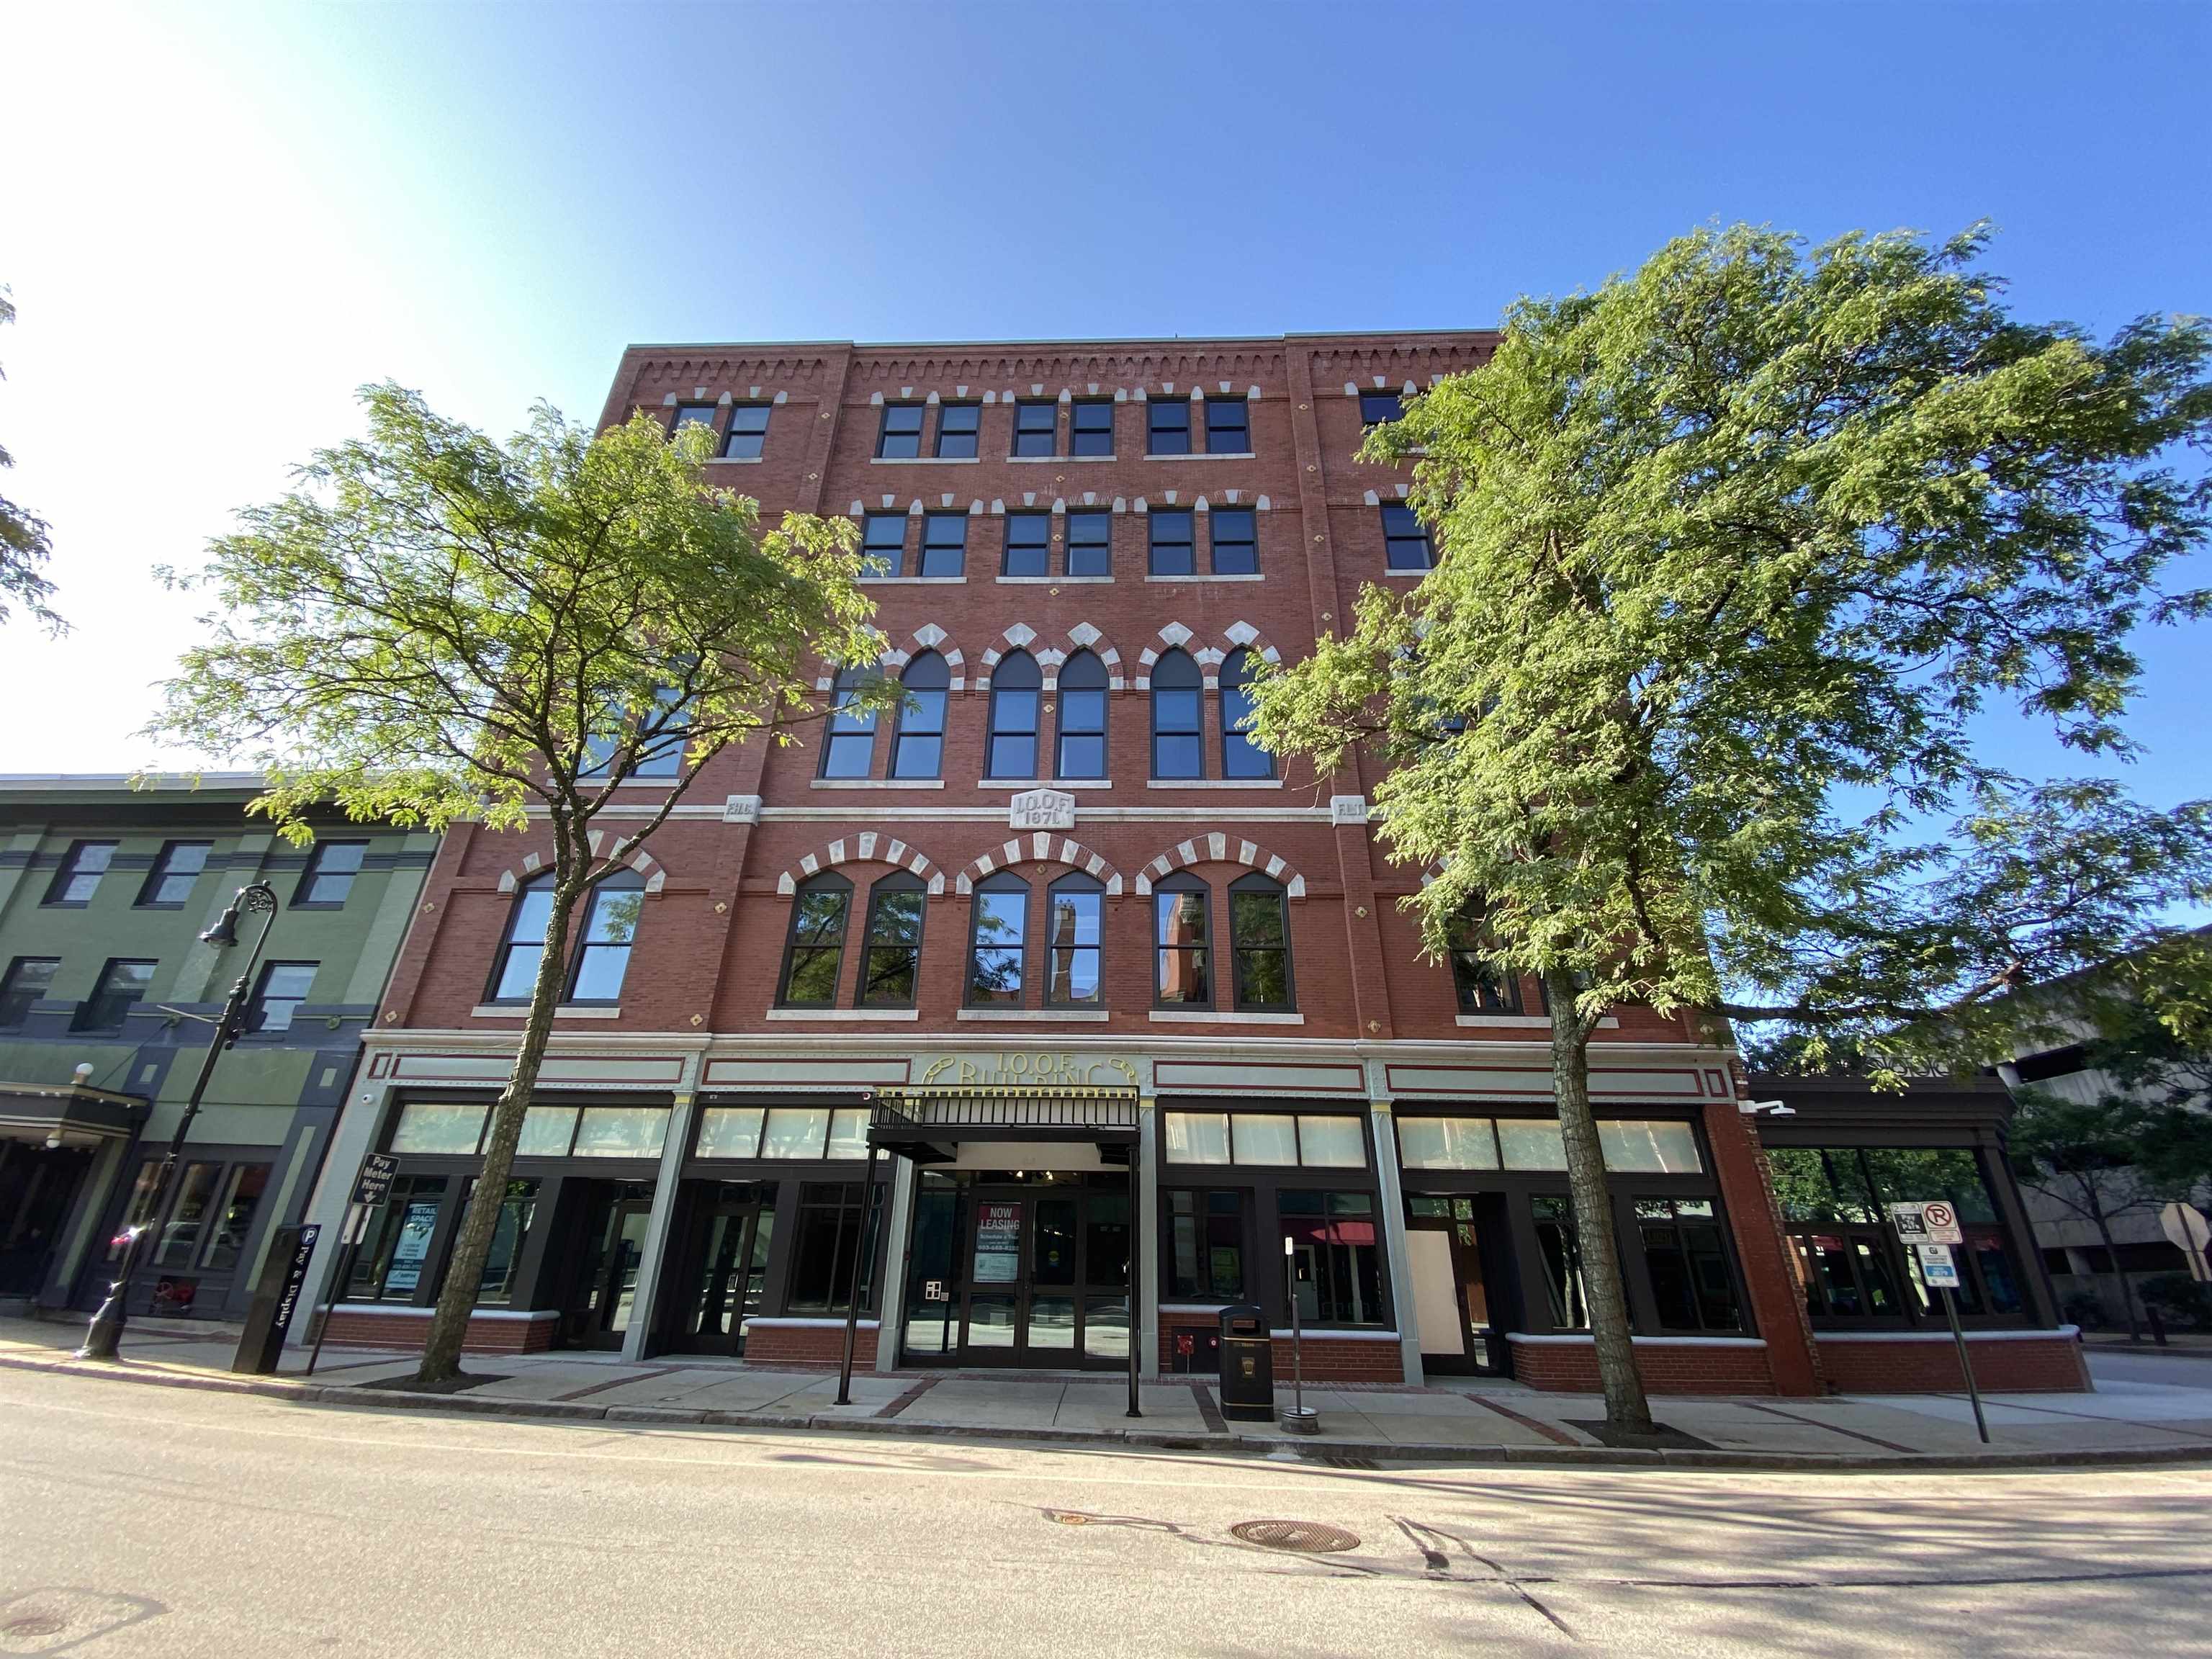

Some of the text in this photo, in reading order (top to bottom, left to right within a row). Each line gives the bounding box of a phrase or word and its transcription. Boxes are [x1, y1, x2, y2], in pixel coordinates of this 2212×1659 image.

[997, 1053, 1075, 1075] I.O.O.F.
[372, 1156, 391, 1169] Pay
[363, 1166, 392, 1180] Meter
[361, 1179, 385, 1191] Here
[989, 1208, 1012, 1218] NOW
[980, 1219, 1020, 1230] LEASING
[275, 1246, 310, 1328] Pay & Display
